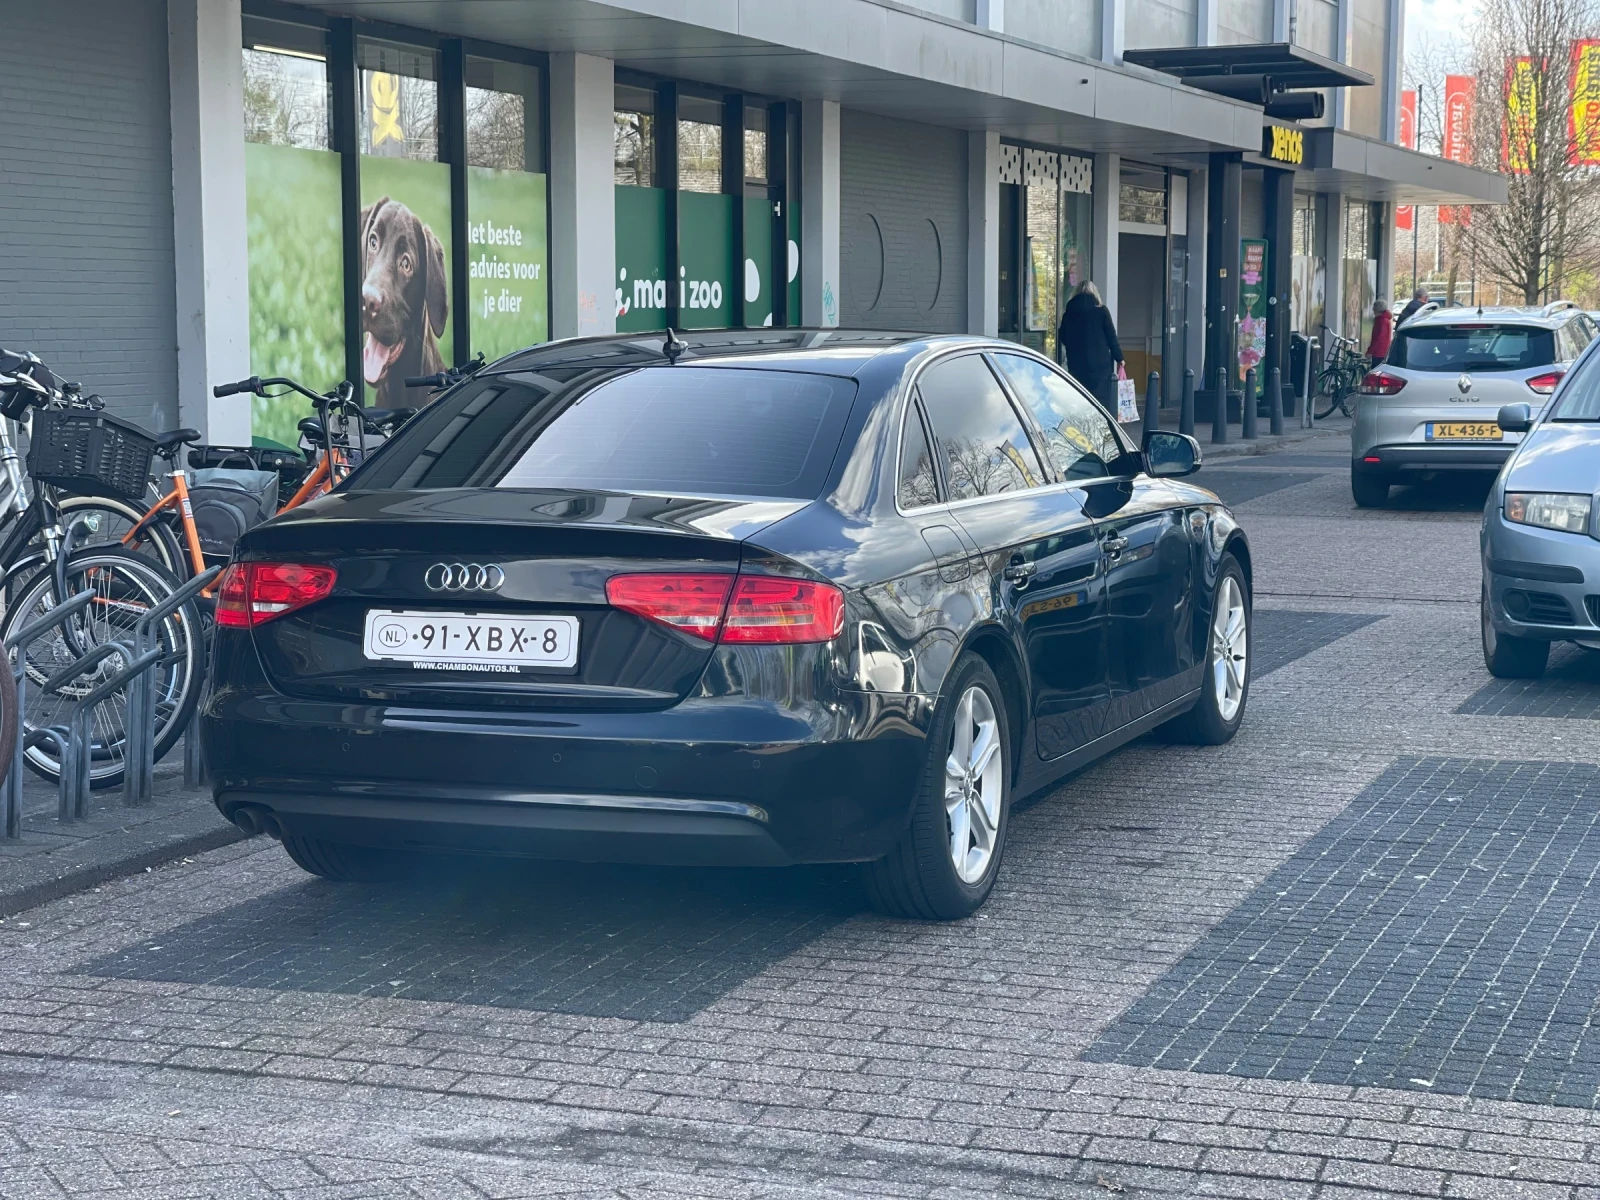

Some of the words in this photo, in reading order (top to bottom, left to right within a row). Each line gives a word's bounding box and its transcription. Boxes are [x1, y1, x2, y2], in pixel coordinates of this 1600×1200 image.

[1271, 125, 1303, 164] xenos
[487, 220, 522, 246] beste
[470, 254, 510, 278] advies
[513, 263, 540, 279] voor
[634, 265, 686, 309] mai
[689, 280, 723, 309] zoo
[483, 288, 495, 319] je
[497, 288, 522, 312] dier
[1438, 425, 1498, 436] XL-436-F
[385, 630, 401, 643] NL
[420, 624, 558, 654] 91-XBX-8
[413, 661, 521, 673] WWW.CHAMBONAUTOS.NL
